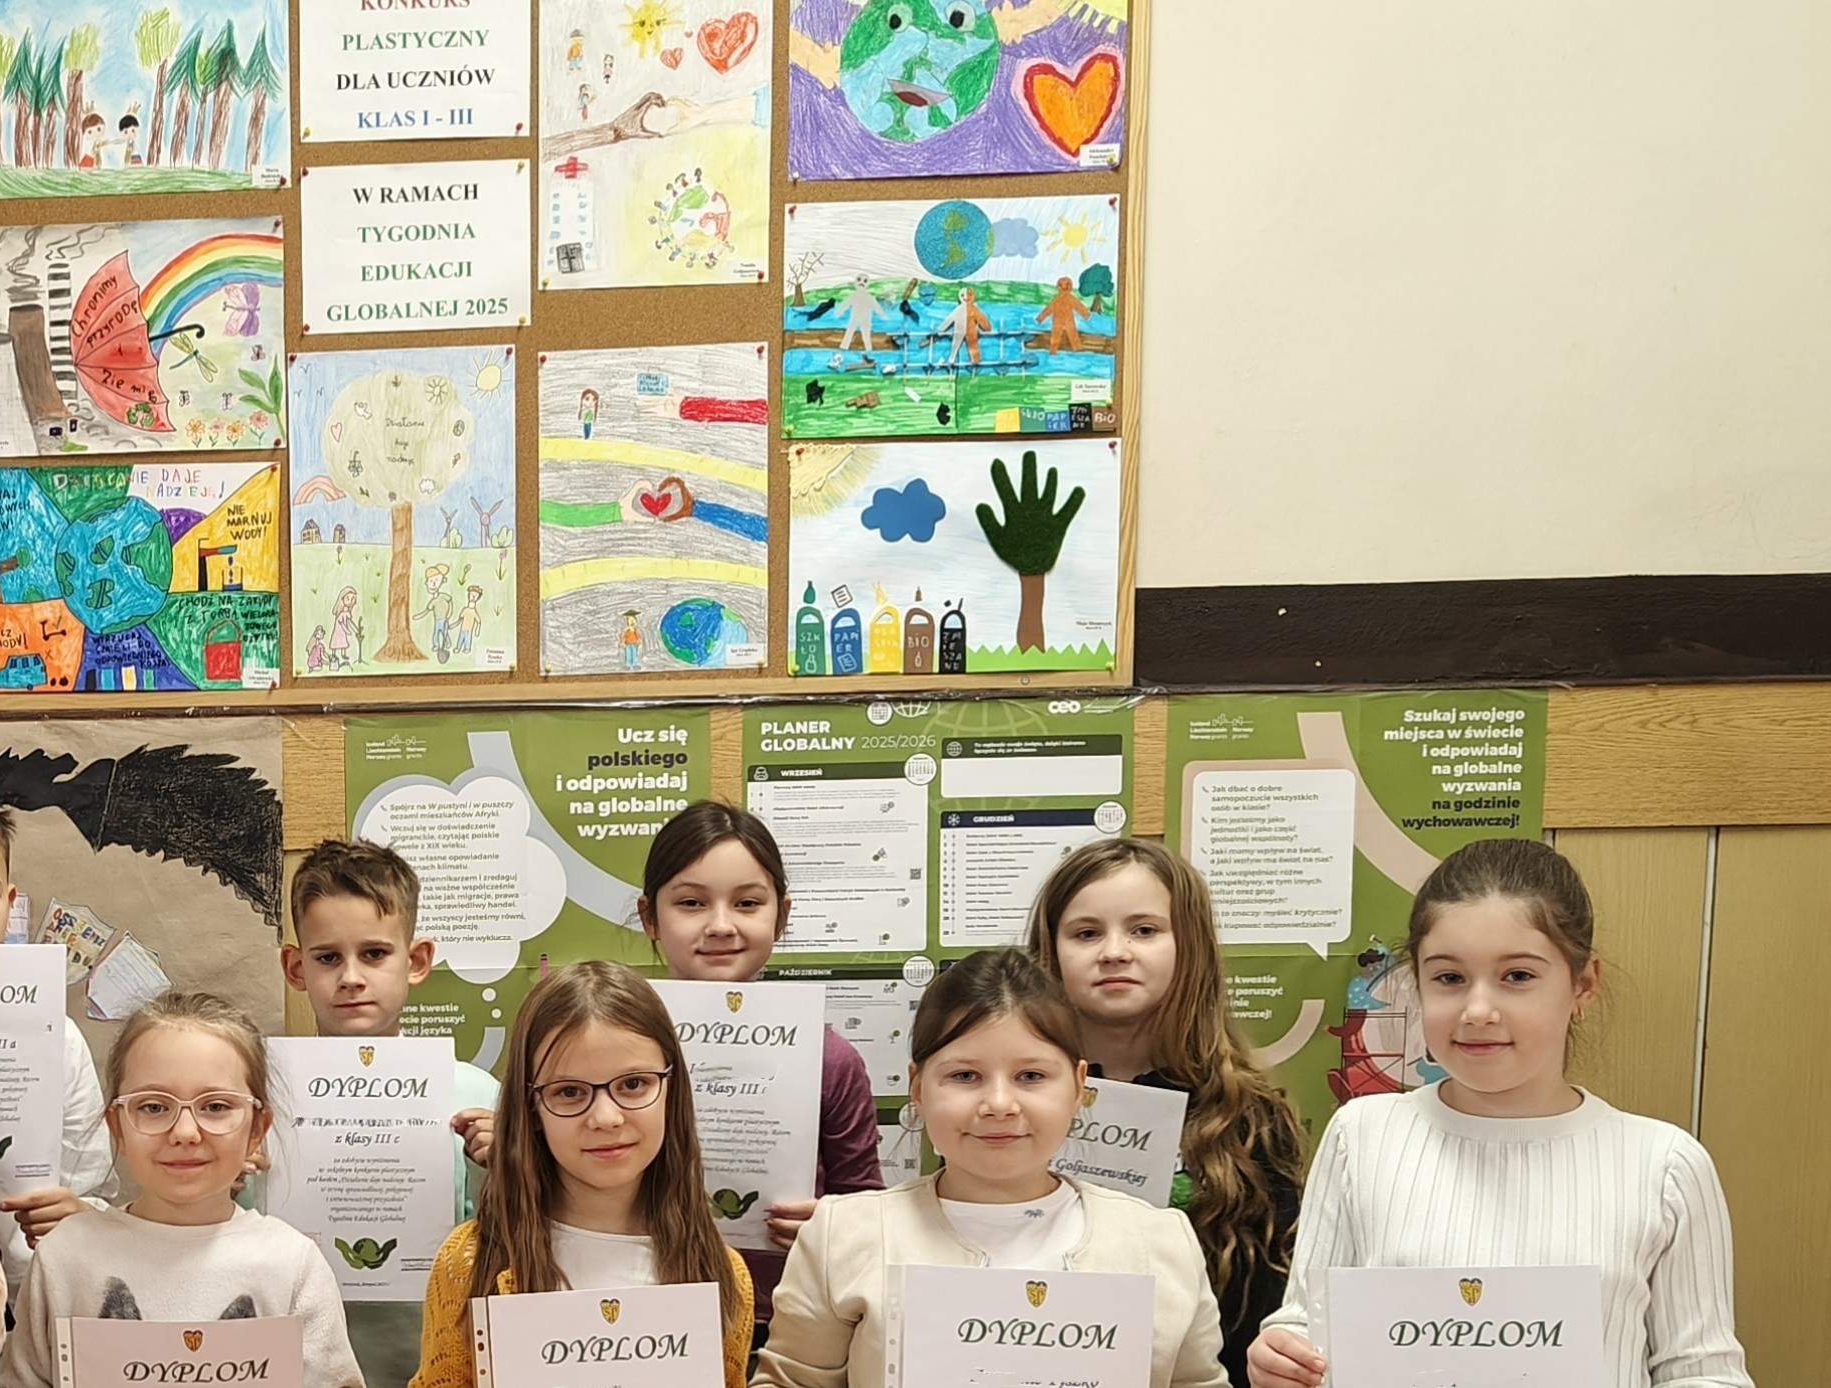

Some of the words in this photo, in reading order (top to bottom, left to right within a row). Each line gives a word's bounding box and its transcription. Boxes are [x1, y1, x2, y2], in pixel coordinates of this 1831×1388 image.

[361, 0, 470, 11] KONKURS
[342, 30, 489, 51] PLASTYCZNY
[337, 73, 380, 90] DLA
[388, 65, 495, 89] UCZNIÓW
[358, 111, 415, 128] KLAS
[423, 110, 429, 125] I
[449, 109, 473, 125] III
[353, 188, 372, 204] W
[380, 184, 479, 204] RAMACH
[357, 223, 475, 243] TYGODNIA
[361, 261, 472, 282] EDUKACJI
[327, 300, 458, 322] GLOBALNEJ
[465, 298, 508, 315] 2025
[161, 469, 201, 484] DAJE
[227, 505, 245, 516] NIE
[227, 512, 272, 527] MARNUJ
[231, 527, 267, 540] WODY!
[219, 596, 233, 606] NA
[1403, 709, 1457, 725] Szukaj
[1458, 707, 1525, 724] swojego
[617, 727, 655, 745] Ucz
[658, 725, 688, 746] się
[760, 720, 831, 736] PLANER
[1384, 726, 1444, 742] miejsca
[1447, 728, 1461, 739] w
[1463, 724, 1524, 739] świecie
[760, 736, 856, 753] GLOBALNY
[861, 734, 936, 750] 2025/2026
[1422, 744, 1427, 757] i
[1430, 742, 1524, 760] odpowiadaj
[588, 749, 688, 771] polskiego
[780, 768, 823, 778] WRZESIEŃ
[1431, 763, 1451, 775] na
[1453, 760, 1522, 777] globalne
[556, 775, 562, 792] i
[566, 772, 688, 794] odpowiadaj
[1228, 785, 1248, 793] dbać
[1441, 778, 1522, 795] wyzwania
[1212, 794, 1271, 803] samopoczucie
[1273, 793, 1319, 802] wszystkich
[1432, 799, 1451, 810] na
[1453, 796, 1521, 812] godzinie
[390, 804, 414, 812] Spójrz
[438, 801, 468, 810] pustyni
[482, 801, 514, 810] puszczy
[570, 801, 594, 814] na
[598, 796, 688, 817] globalne
[420, 811, 474, 819] mieszkańców
[973, 814, 1014, 823] GRUDZIEŃ
[1401, 814, 1520, 830] wychowawczej!
[390, 824, 414, 832] Wczuj
[438, 833, 470, 841] czytając
[419, 854, 447, 862] własne
[449, 853, 499, 862] opowiadanie
[483, 873, 517, 882] zredaguj
[462, 883, 515, 891] współcześnie
[434, 902, 486, 910] sprawiedliwy
[432, 915, 463, 923] wszyscy
[464, 913, 499, 922] jesteśmy
[441, 935, 460, 943] który
[778, 967, 832, 977] PAŹDZIERNIK
[1235, 975, 1277, 984] kwestie
[1235, 986, 1283, 996] poruszyć
[419, 1003, 459, 1013] kwestie
[420, 1013, 466, 1025] poruszyć
[419, 1026, 453, 1037] języka
[675, 1022, 798, 1047] DYPLOM
[10, 1040, 16, 1049] a
[308, 1076, 429, 1098] DYPLOM
[694, 1083, 702, 1093] z
[706, 1081, 736, 1097] klasy
[739, 1083, 759, 1095] III
[335, 1134, 342, 1144] z
[344, 1132, 372, 1146] klasy
[374, 1133, 392, 1144] III
[393, 1135, 401, 1144] c
[1067, 1118, 1152, 1151] PLOM
[958, 1318, 1118, 1350] DYPLOM
[1388, 1318, 1564, 1348] DYPLOM
[541, 1332, 689, 1365] DYPLOM
[123, 1358, 270, 1383] DYPLOM
